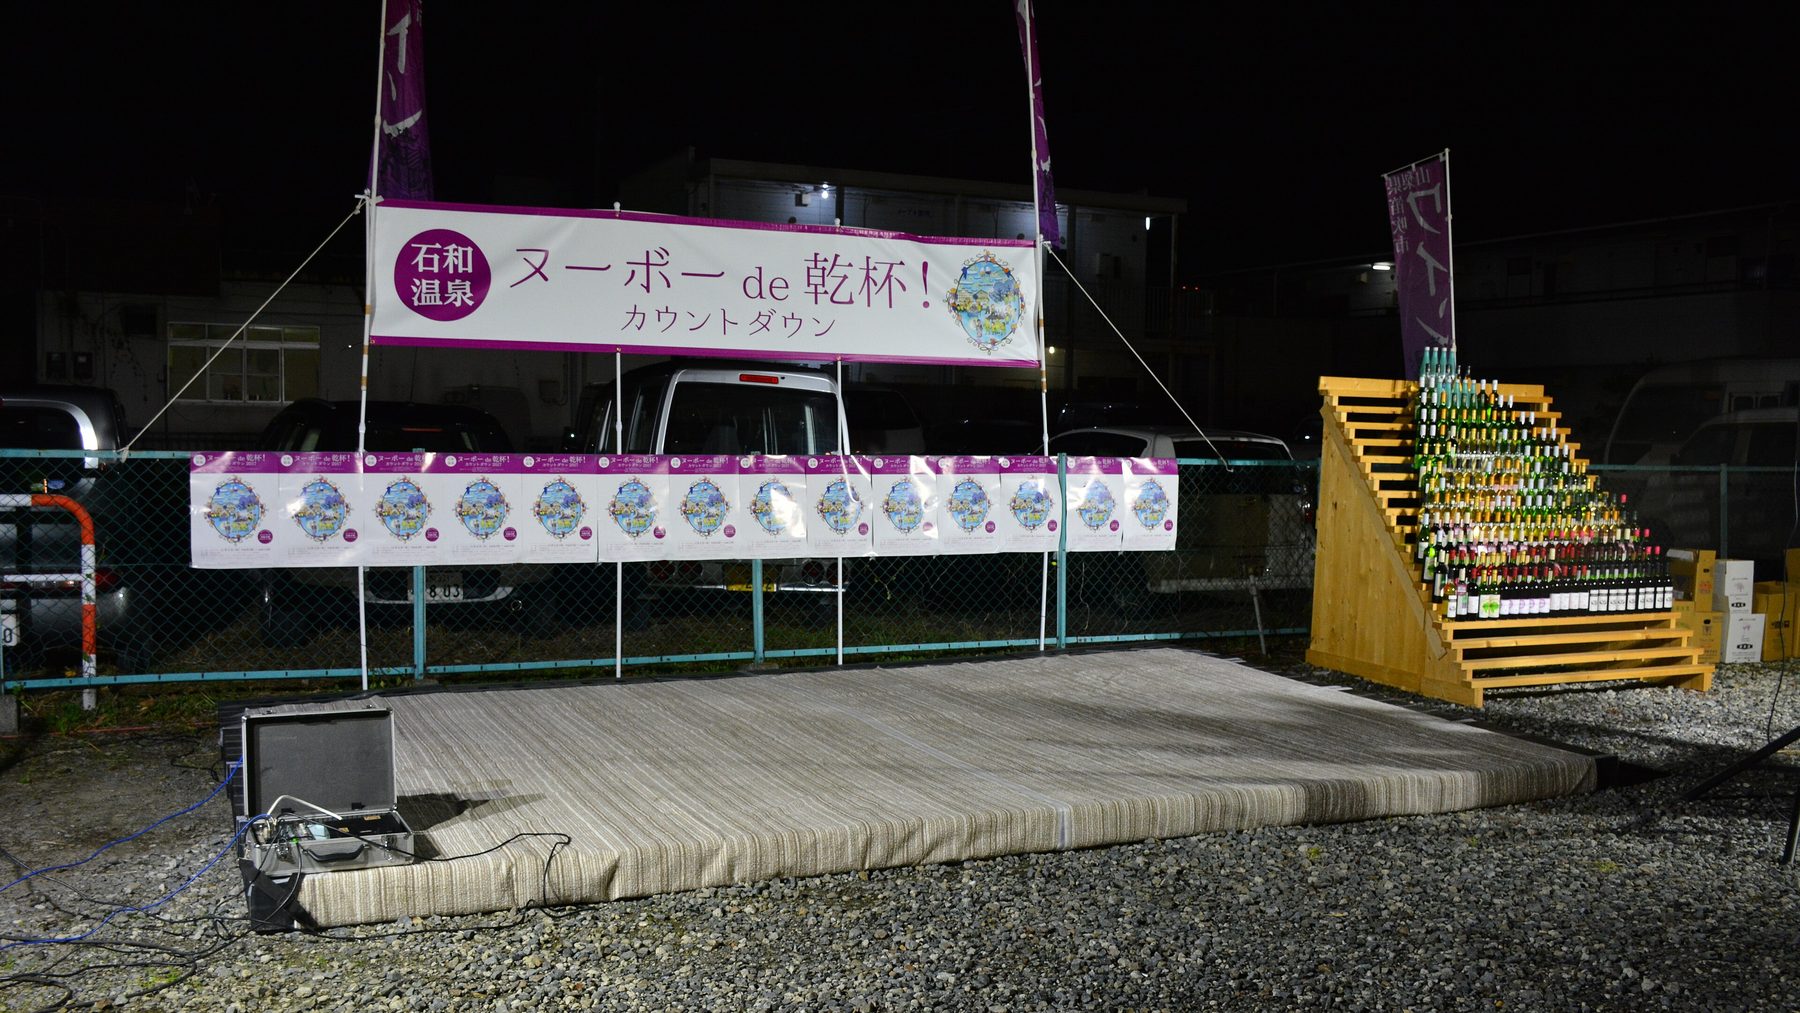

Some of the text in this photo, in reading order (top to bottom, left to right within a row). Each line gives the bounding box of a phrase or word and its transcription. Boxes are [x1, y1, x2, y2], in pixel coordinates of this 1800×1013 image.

[410, 242, 474, 275] 石和
[410, 277, 475, 308] 温泉
[508, 245, 931, 310] ヌーボー de 乾杯!
[620, 305, 837, 339] カウントダウン
